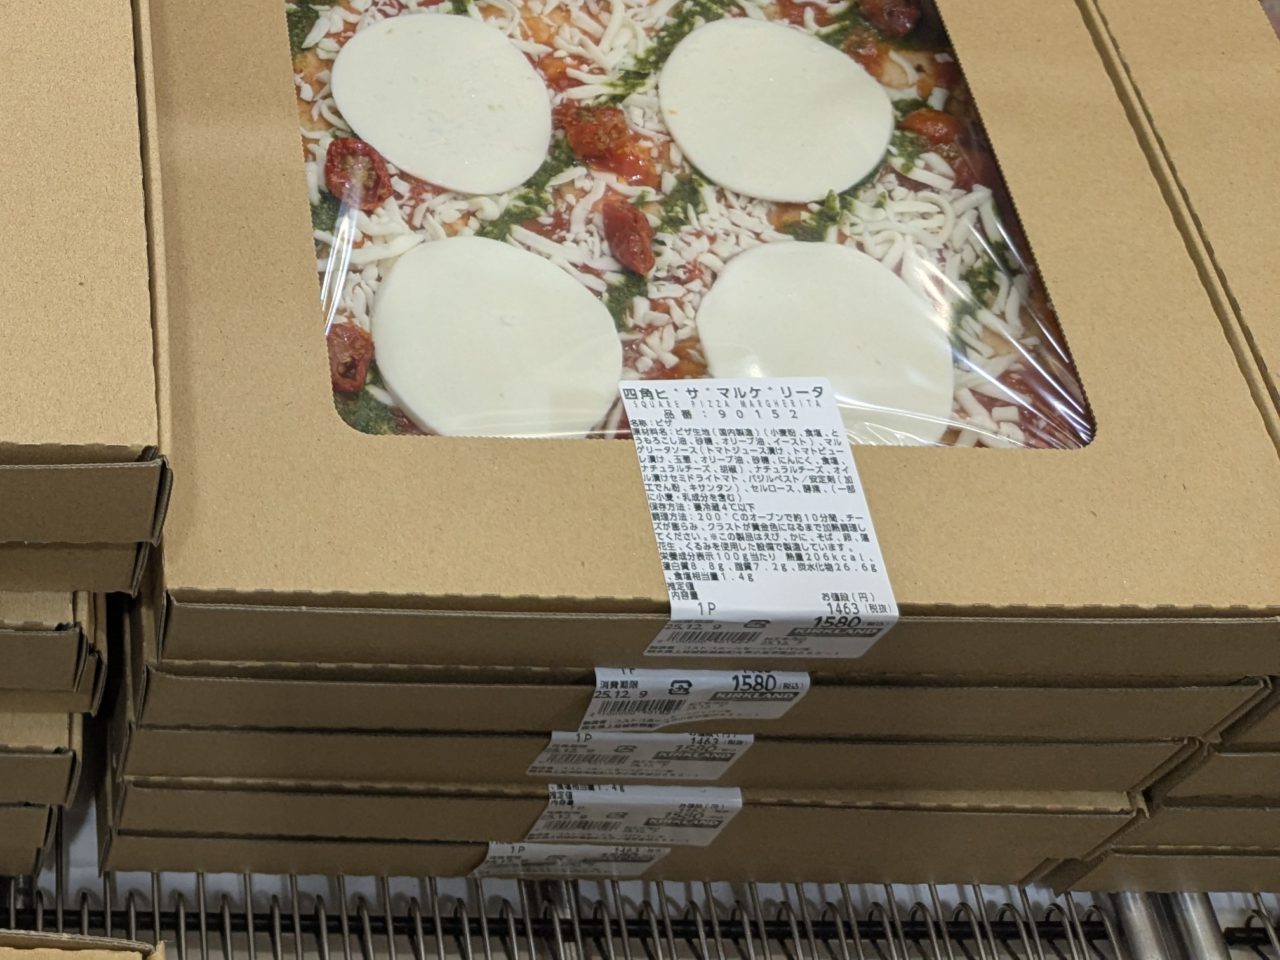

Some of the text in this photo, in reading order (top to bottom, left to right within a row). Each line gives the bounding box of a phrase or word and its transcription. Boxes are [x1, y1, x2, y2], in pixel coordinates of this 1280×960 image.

[632, 400, 822, 408] SQUARE PIZZA MARGHERITA
[697, 602, 717, 616] 1P
[826, 602, 860, 615] 1463
[813, 616, 861, 628] 1580
[732, 674, 777, 691] 1580
[712, 692, 797, 701] KIRKLAND
